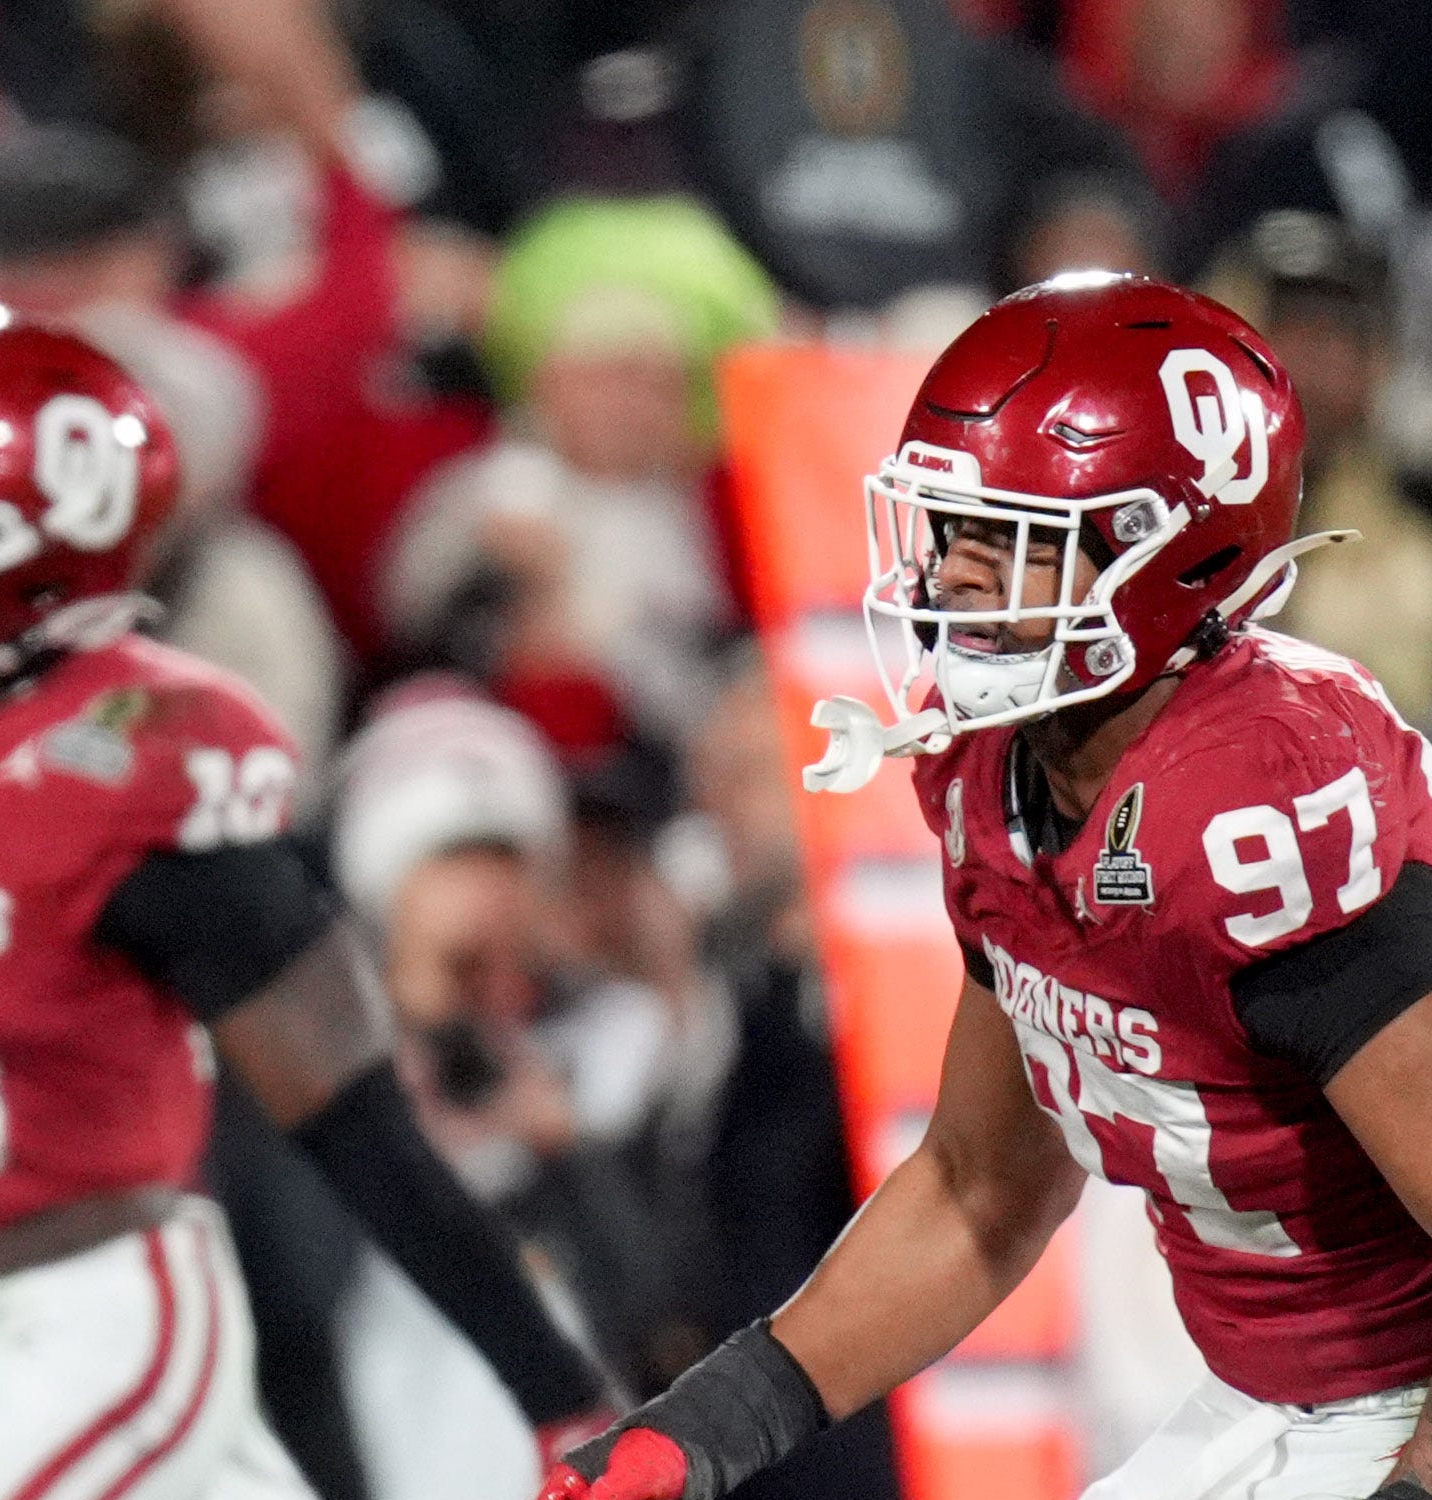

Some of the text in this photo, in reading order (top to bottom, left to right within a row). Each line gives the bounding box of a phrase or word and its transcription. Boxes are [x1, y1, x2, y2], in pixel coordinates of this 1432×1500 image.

[34, 390, 140, 552] OU
[1158, 348, 1269, 505] OU
[179, 746, 297, 852] 10
[1202, 766, 1382, 948] 97
[1014, 1018, 1302, 1258] 97
